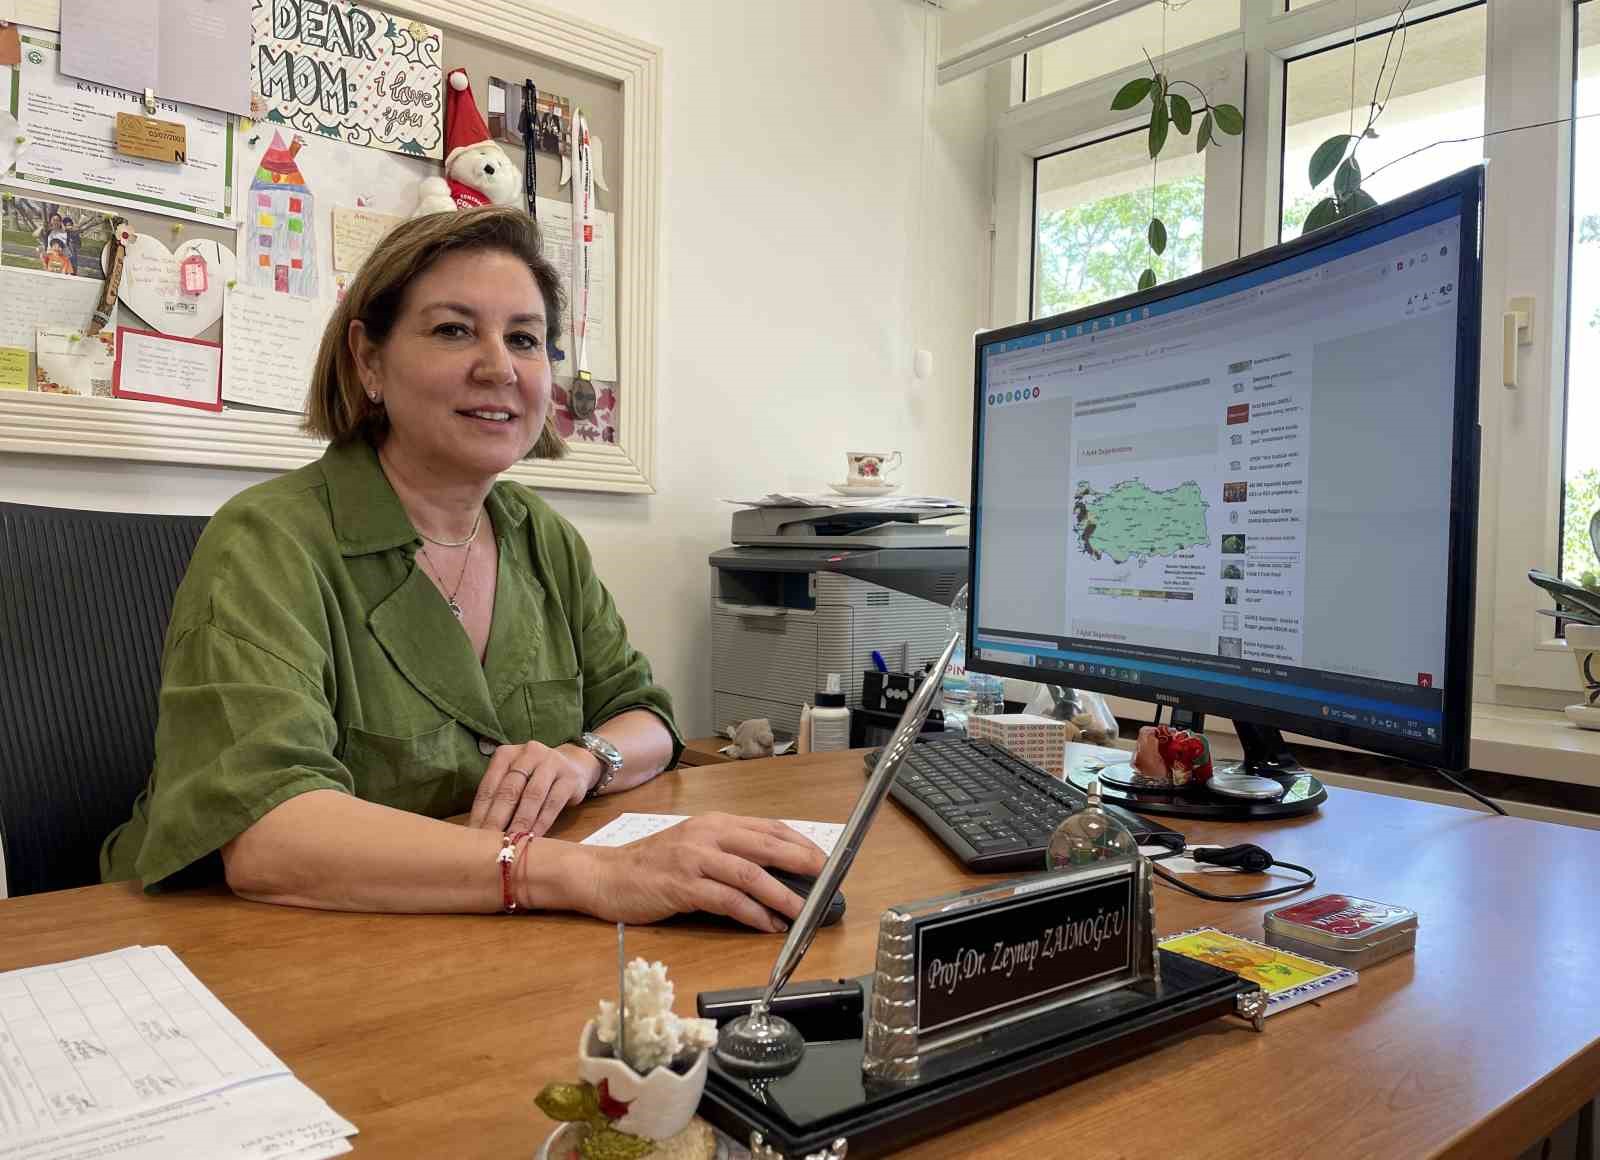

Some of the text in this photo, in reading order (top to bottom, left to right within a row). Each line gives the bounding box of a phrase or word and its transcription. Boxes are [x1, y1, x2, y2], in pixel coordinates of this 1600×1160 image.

[272, 0, 377, 61] DEAR
[76, 82, 127, 101] KATILIM
[389, 71, 435, 108] love
[382, 106, 424, 137] you
[928, 905, 1125, 995] Prof.Dr. Zeynep ZAİMOĞLU
